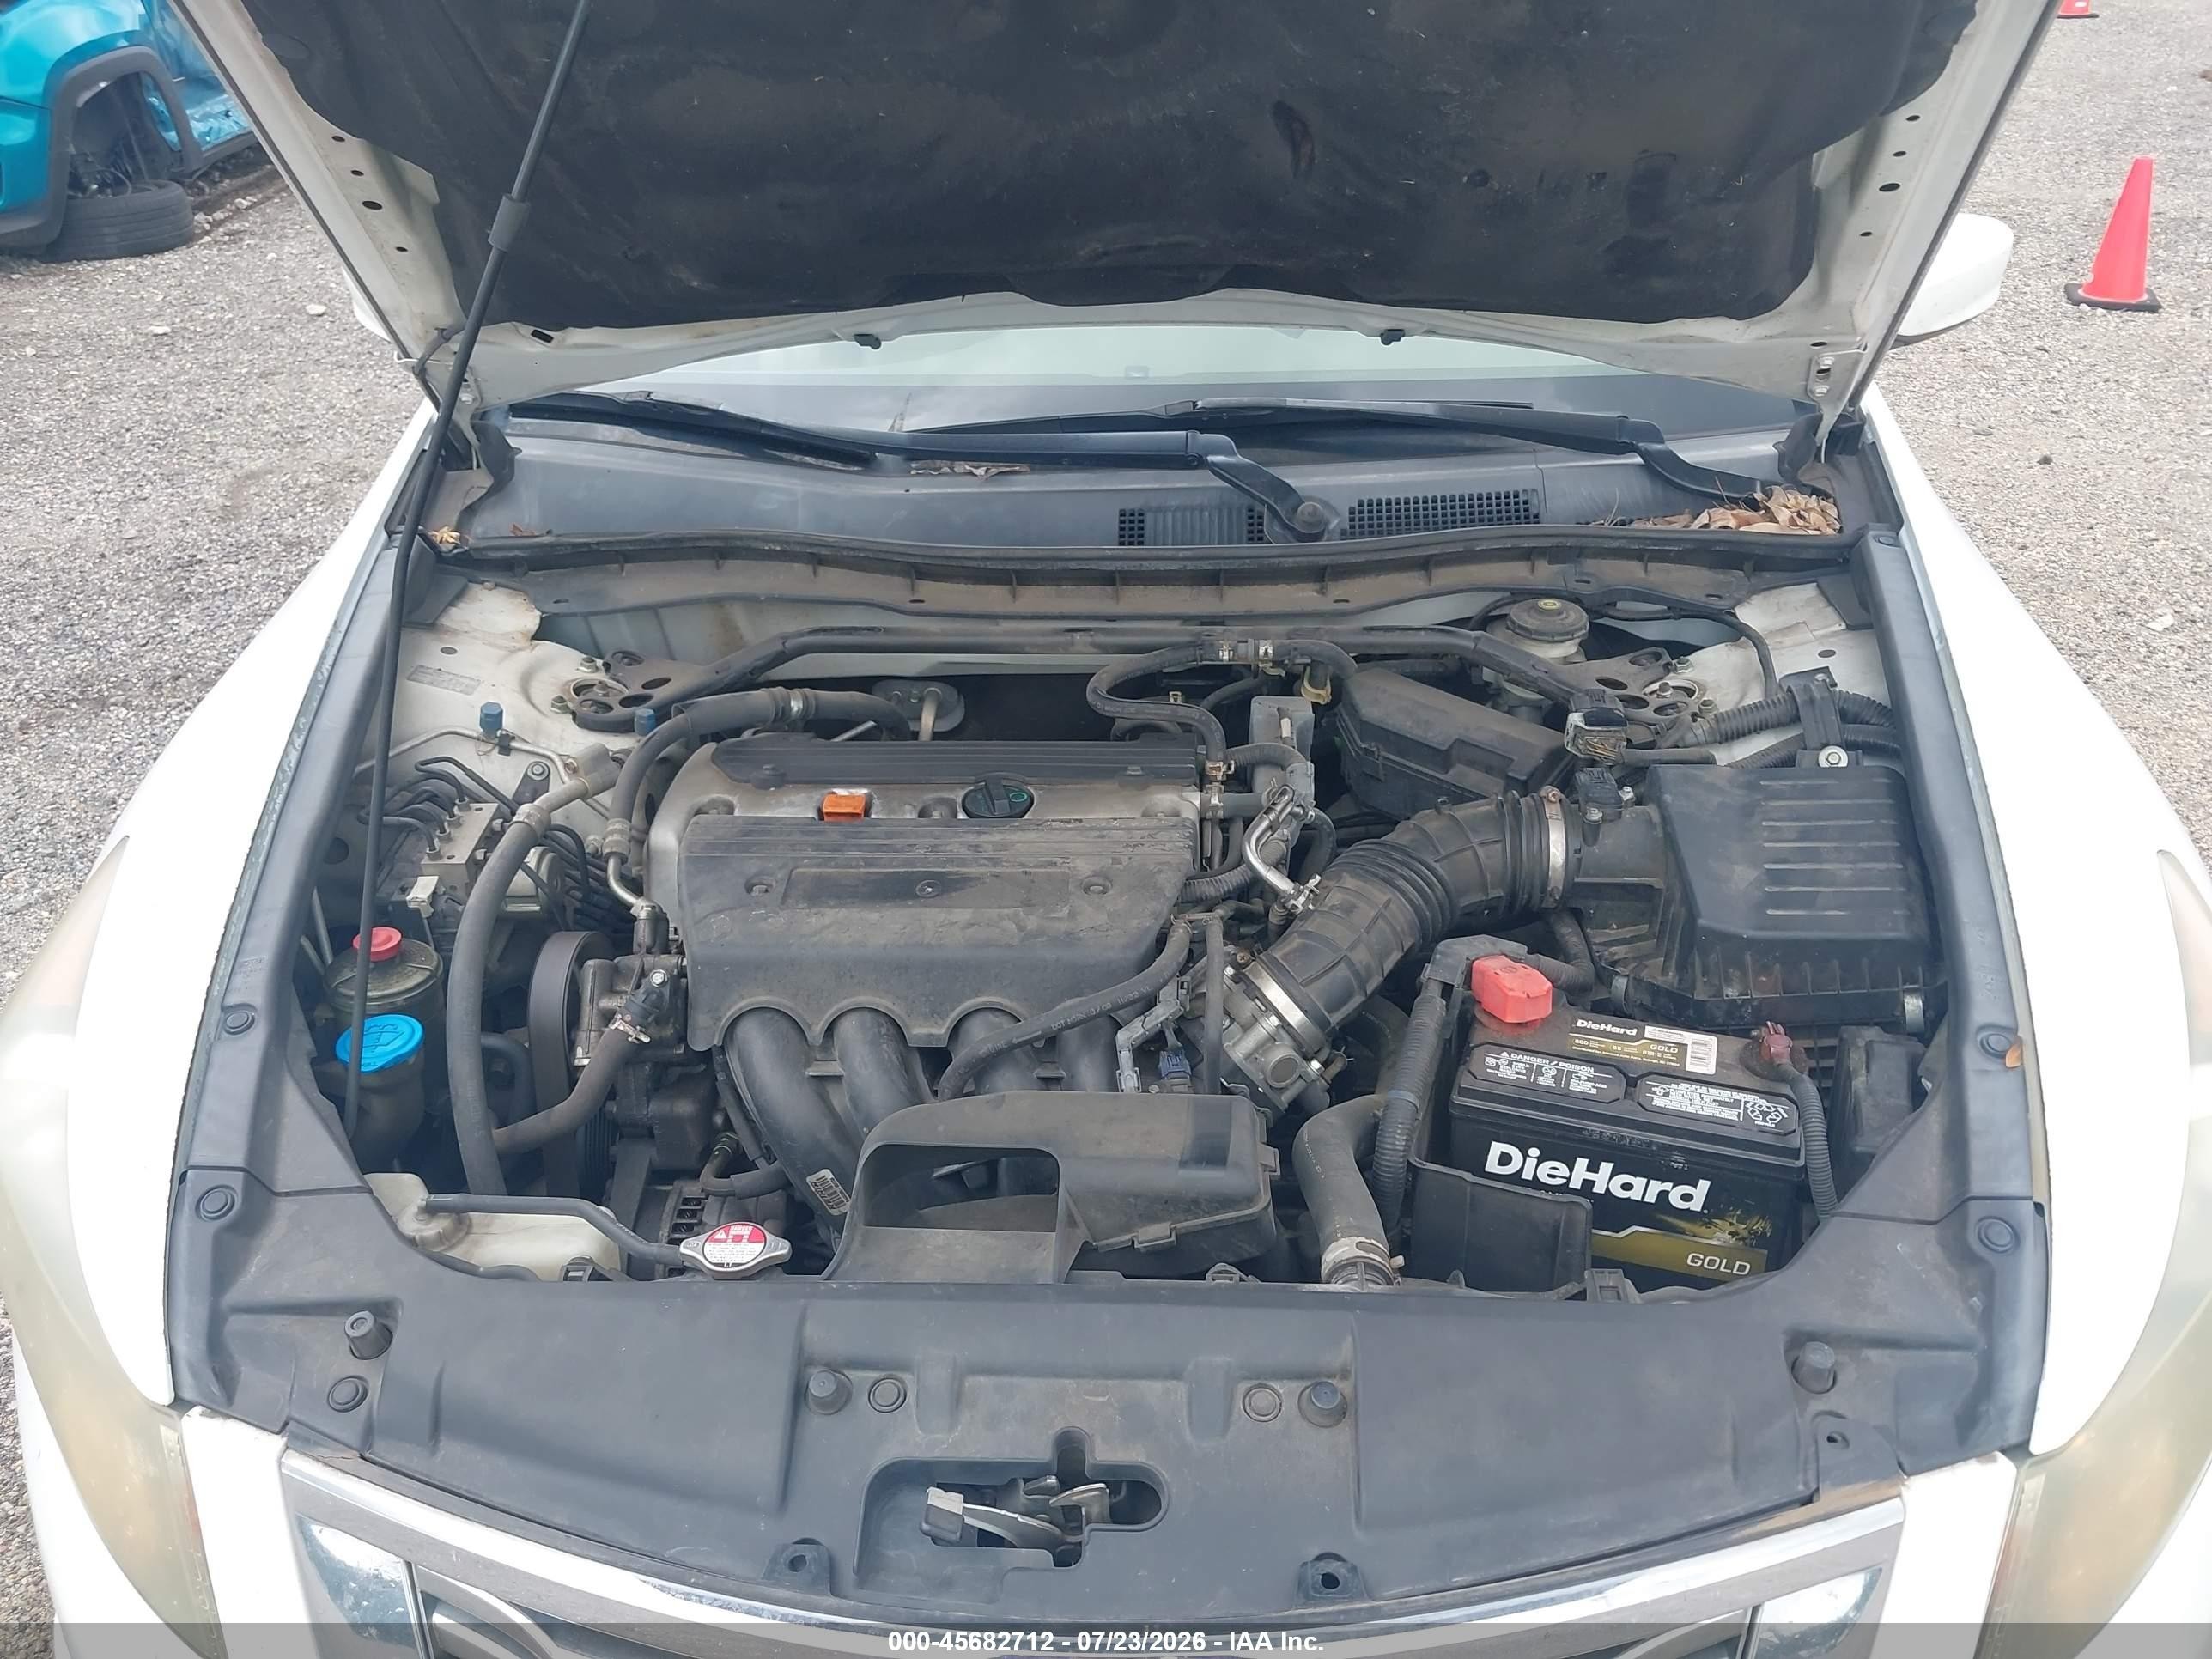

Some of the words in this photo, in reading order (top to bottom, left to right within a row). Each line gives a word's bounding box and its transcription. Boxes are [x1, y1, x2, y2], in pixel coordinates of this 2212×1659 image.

[1576, 1018, 1638, 1036] DieHard
[1650, 1043, 1679, 1054] GOLD
[1510, 1053, 1551, 1066] DANGER
[1559, 1061, 1595, 1073] POISON
[1485, 1140, 1711, 1212] DieHard
[1686, 1253, 1751, 1275] GOLD
